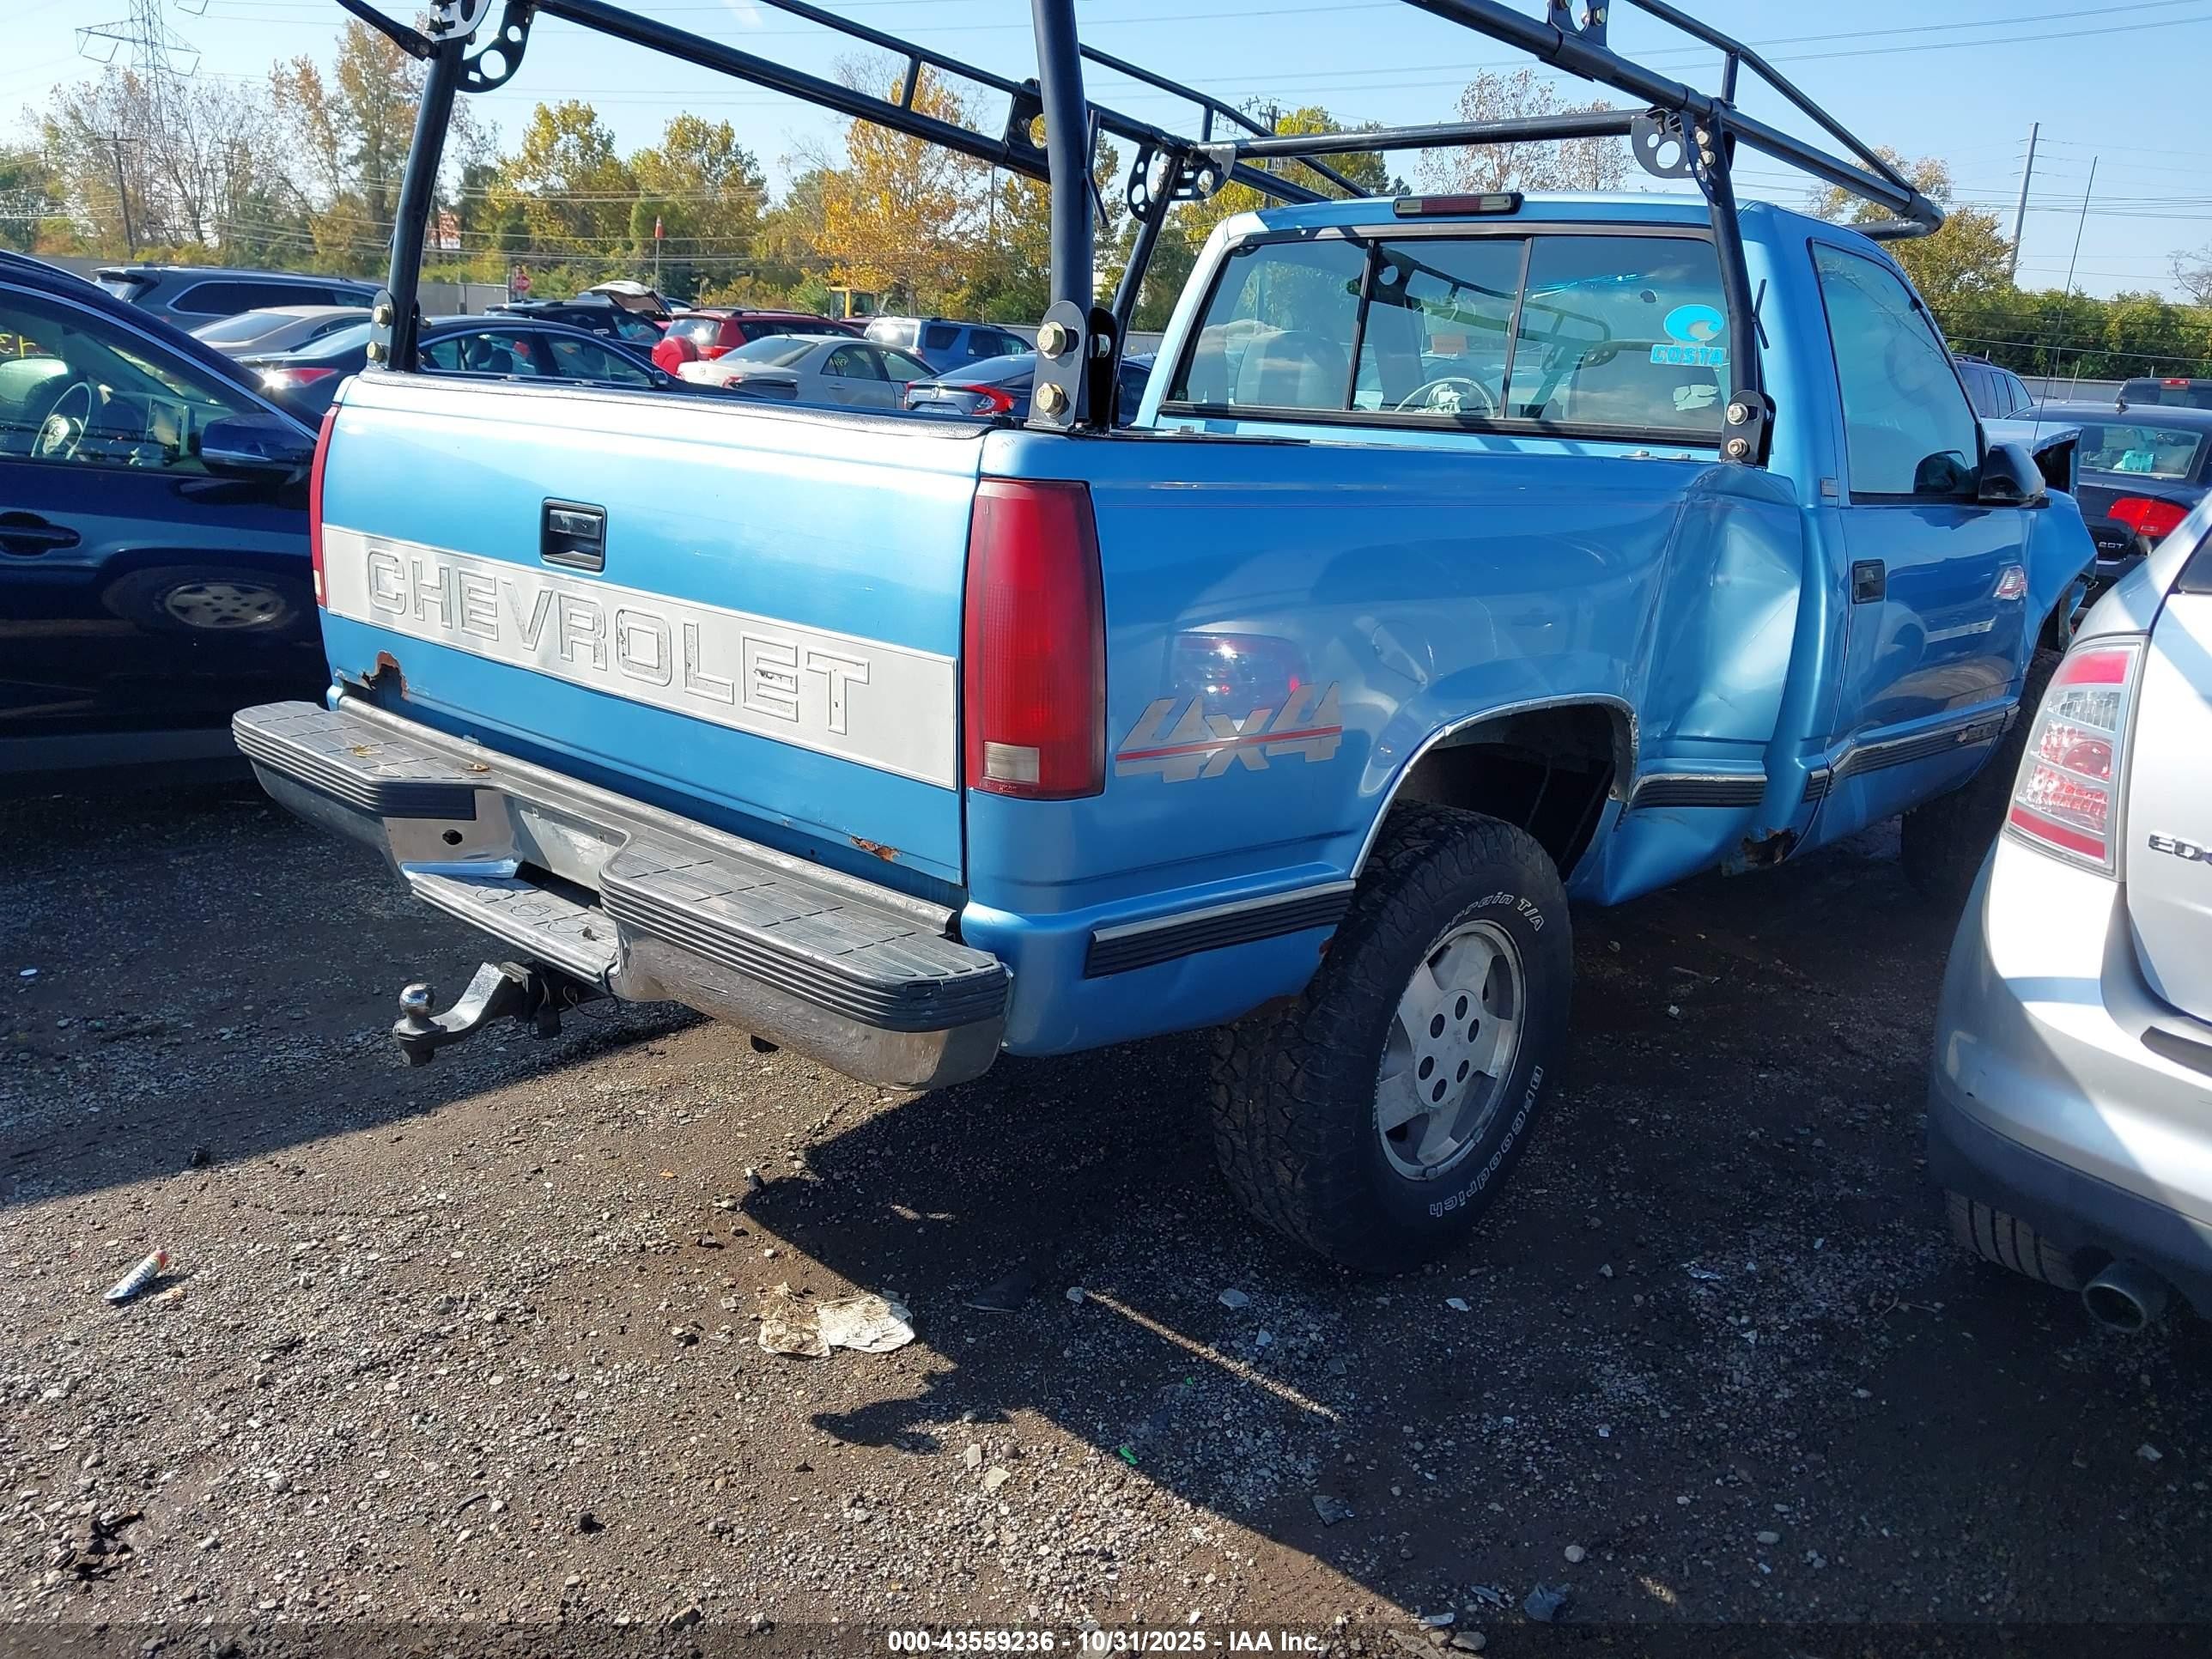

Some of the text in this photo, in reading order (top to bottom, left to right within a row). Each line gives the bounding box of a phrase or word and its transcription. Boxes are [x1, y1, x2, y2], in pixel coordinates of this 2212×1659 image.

[1651, 345, 1723, 366] COSTA
[366, 547, 871, 736] CHEVROLET
[1516, 898, 1545, 932] T/A
